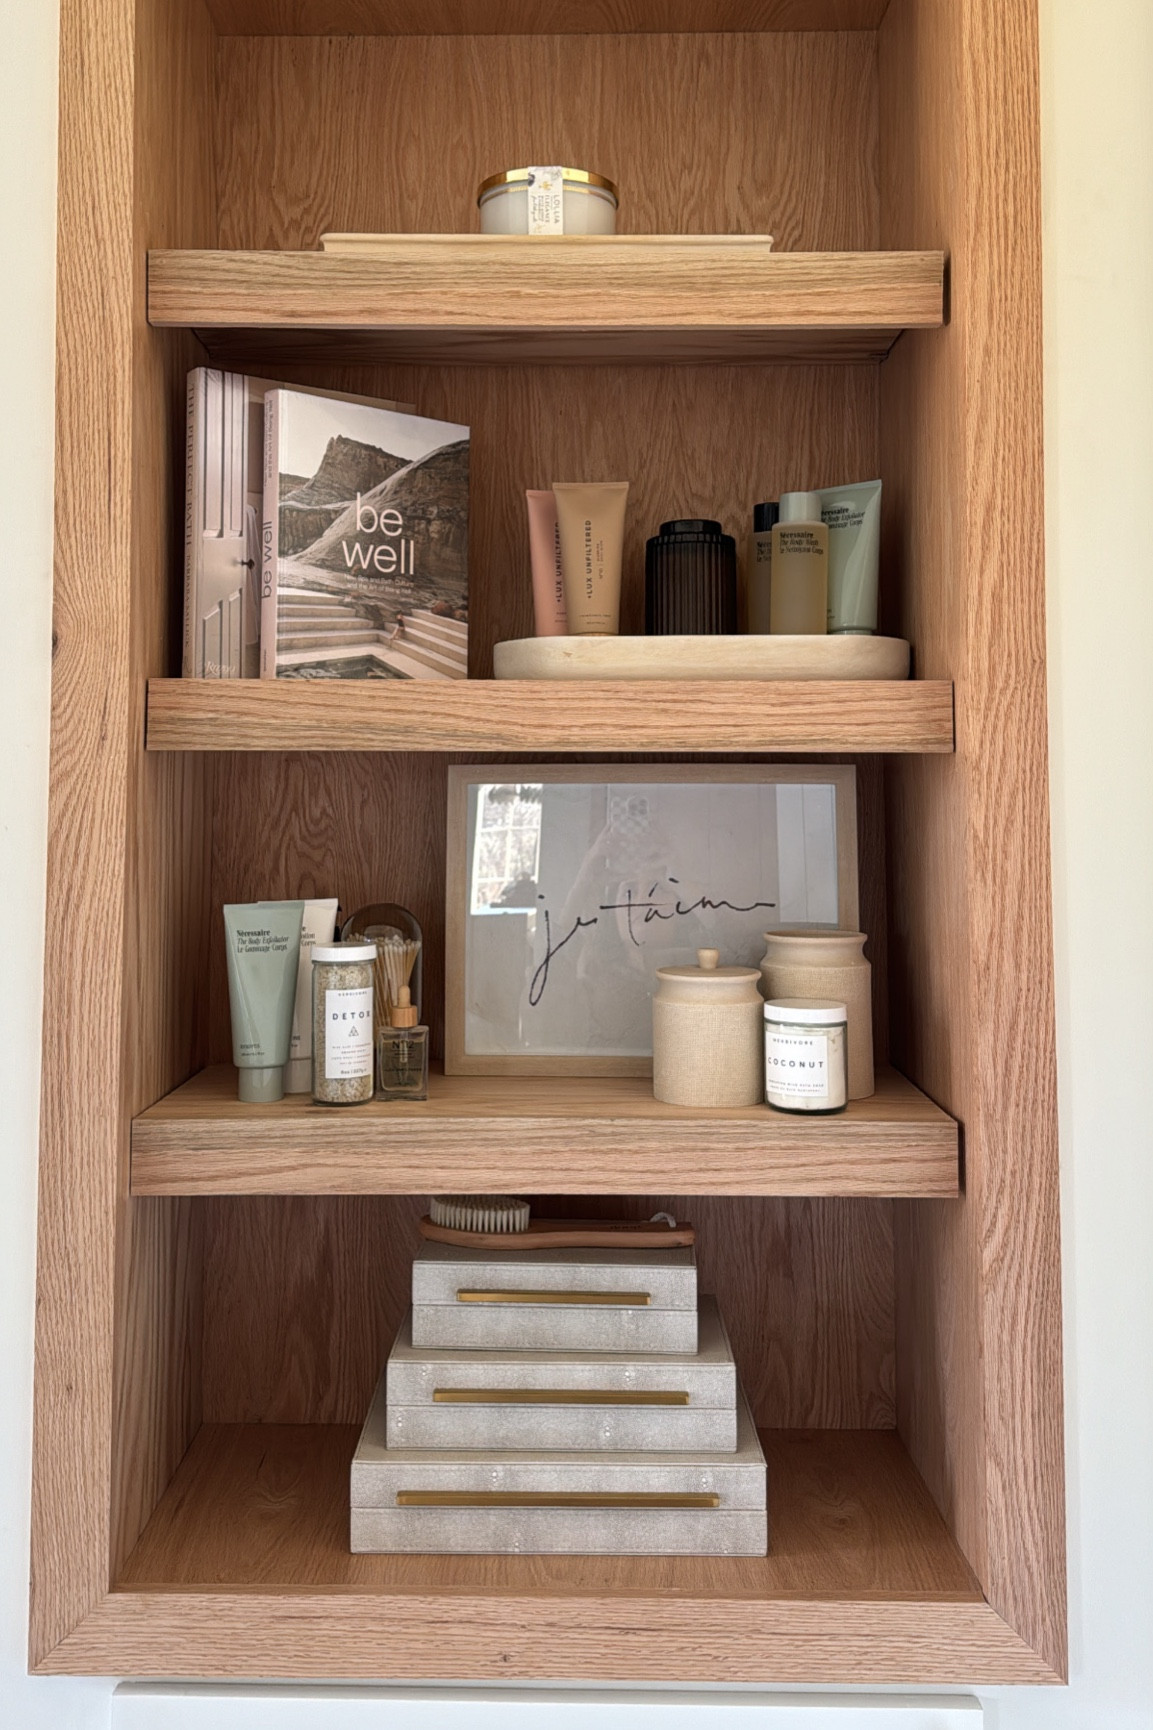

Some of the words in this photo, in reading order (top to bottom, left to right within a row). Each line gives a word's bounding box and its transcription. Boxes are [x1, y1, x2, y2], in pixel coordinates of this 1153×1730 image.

[553, 194, 561, 224] LOLLIA
[187, 385, 195, 416] THE
[186, 424, 194, 496] PERFECT
[356, 491, 403, 537] be
[262, 520, 273, 564] well
[341, 538, 415, 575] well
[584, 520, 592, 574] UNFILTERED
[261, 570, 273, 599] be
[238, 937, 247, 945] The
[248, 937, 262, 946] Body
[262, 935, 289, 945] Exfoliator
[529, 895, 599, 1007] je
[332, 1010, 371, 1020] DETOX
[767, 1056, 824, 1069] COCONUT
